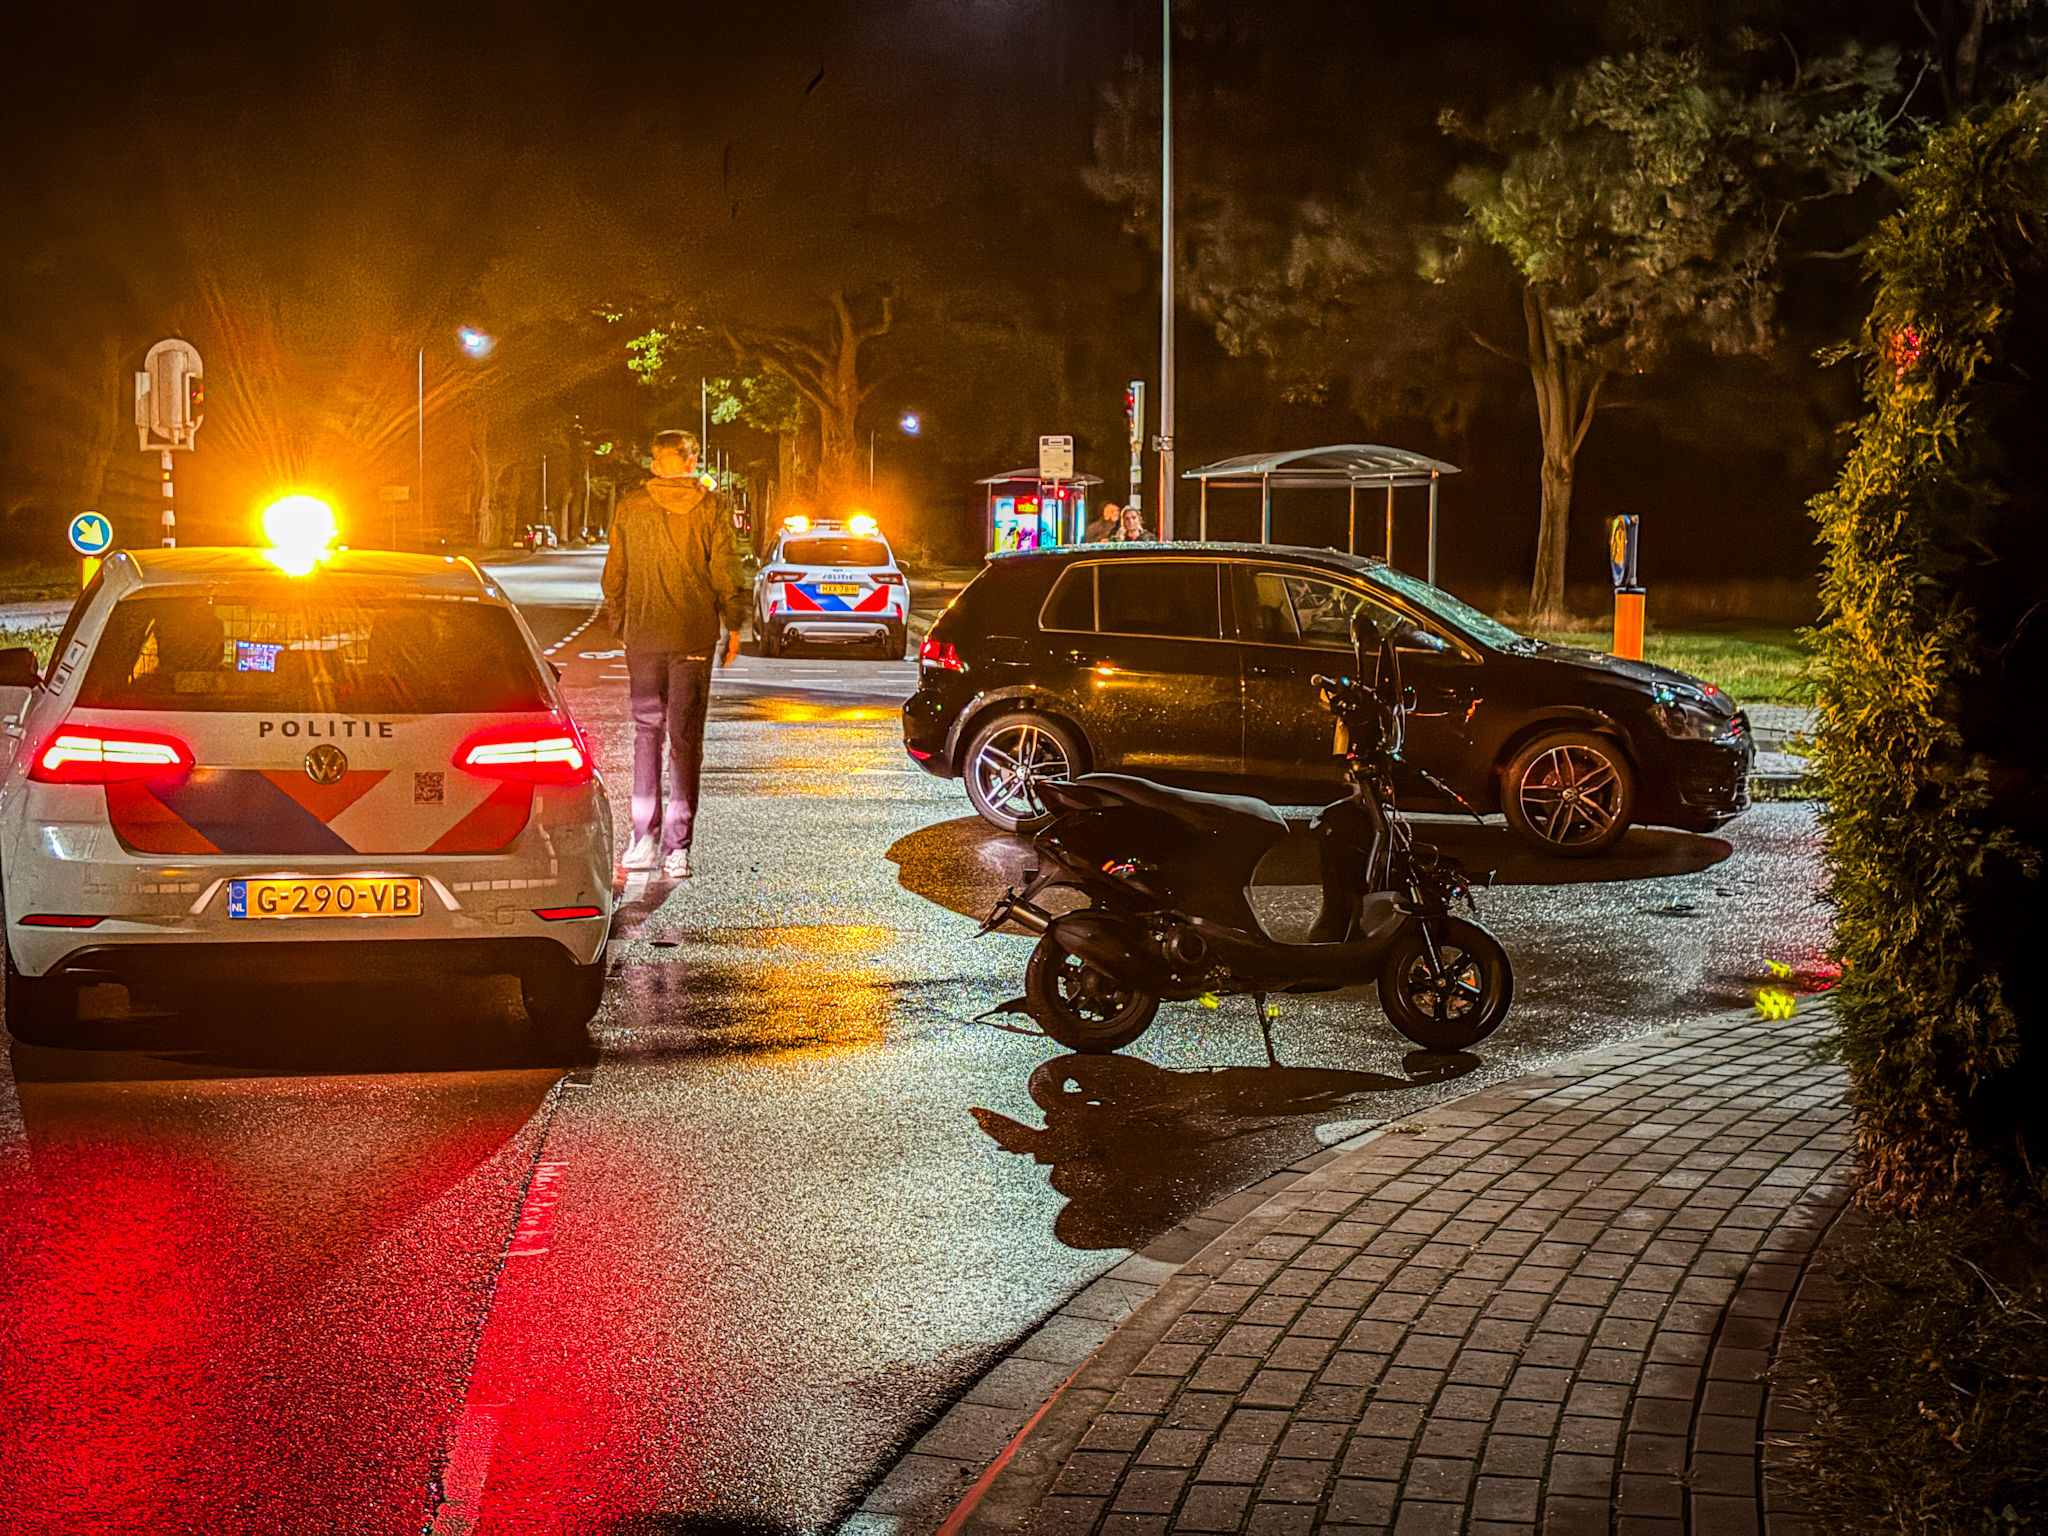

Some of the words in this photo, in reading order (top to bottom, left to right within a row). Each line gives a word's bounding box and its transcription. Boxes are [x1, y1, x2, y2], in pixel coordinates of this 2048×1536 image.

[259, 720, 393, 738] POLITIE
[231, 903, 245, 912] NL
[257, 884, 412, 913] G-290-VB
